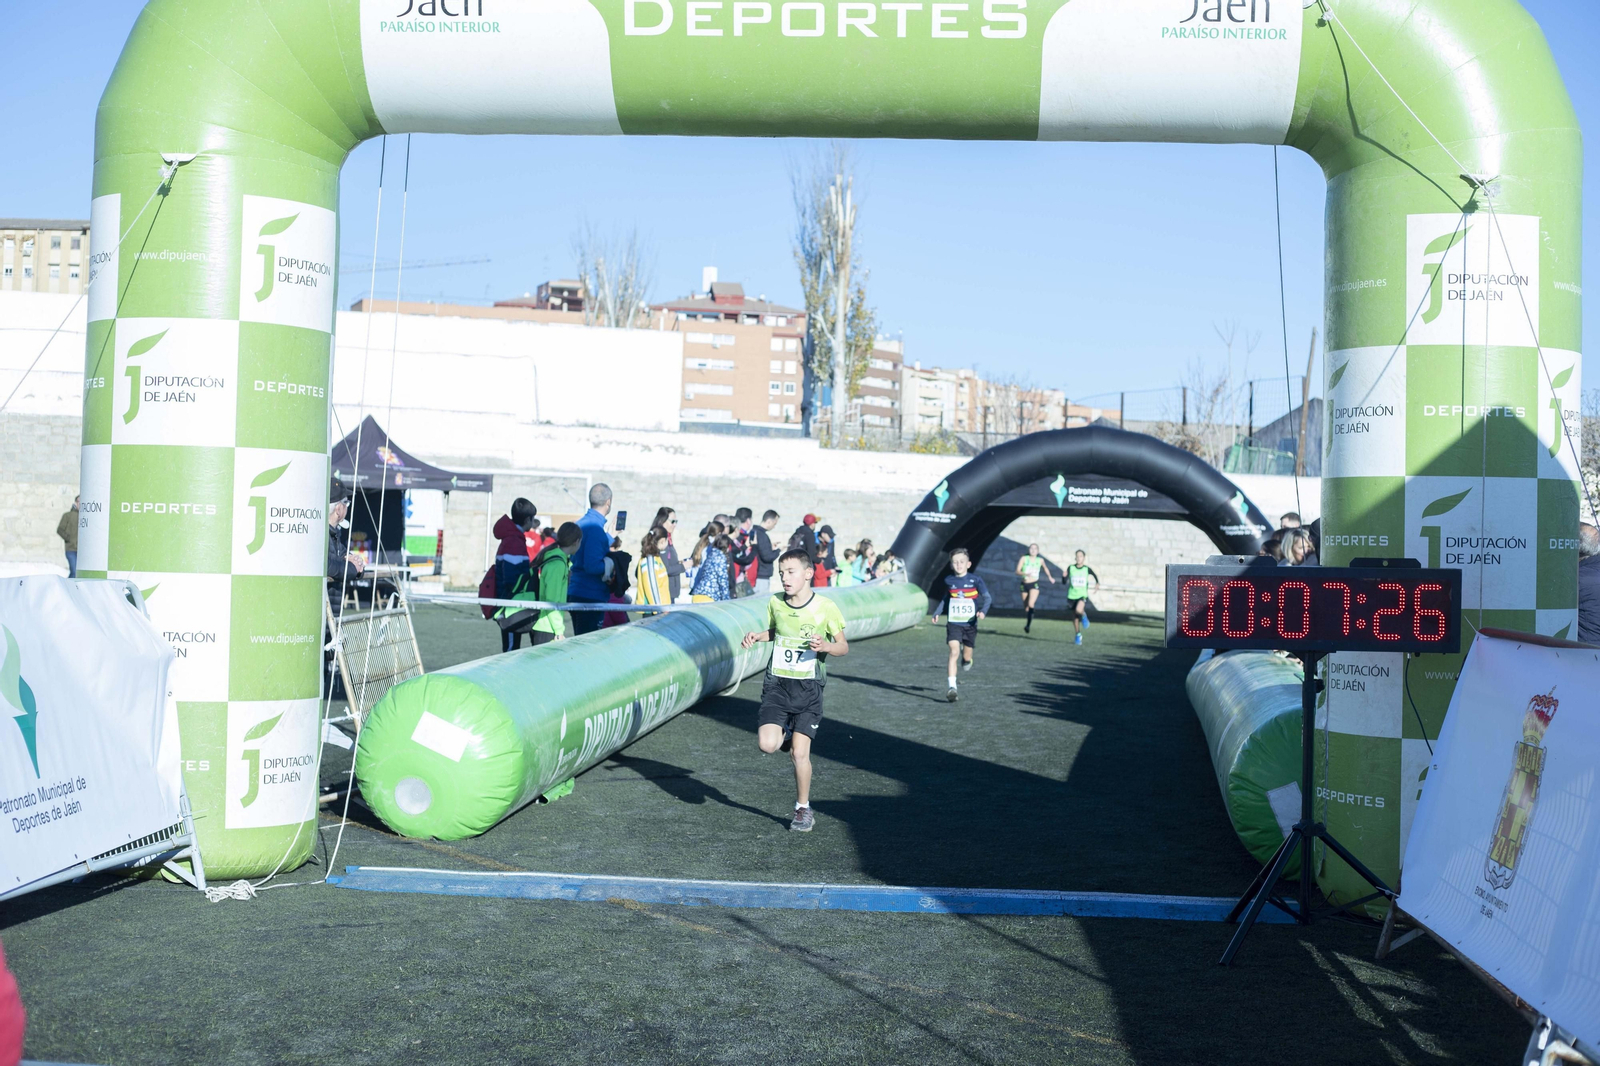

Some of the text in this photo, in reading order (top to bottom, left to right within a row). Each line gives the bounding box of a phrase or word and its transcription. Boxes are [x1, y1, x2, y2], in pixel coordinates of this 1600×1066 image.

[380, 18, 501, 33] PARAÍSO INTERIOR
[623, 0, 1028, 39] DEPORTES
[1161, 25, 1287, 40] PARAÍSO INTERIOR
[278, 256, 331, 276] DIPUTACIÓN
[278, 271, 318, 288] DE JAÉN
[1448, 272, 1529, 286] DIPUTACIÓN
[1448, 288, 1503, 301] DE JAÉN
[144, 375, 225, 388] DIPUTACIÓN
[144, 390, 196, 402] DE JAÉN
[254, 380, 324, 398] DEPORTES
[1335, 404, 1394, 419] DIPUTACIÓN
[1423, 404, 1526, 418] DEPORTES
[1335, 421, 1370, 435] DE JAÉN
[1068, 486, 1149, 498] Patronato Municipal de
[1068, 494, 1101, 504] Deportes
[1101, 495, 1111, 504] de
[121, 502, 217, 515] DEPORTES
[270, 506, 322, 520] DIPUTACIÓN
[270, 521, 309, 534] DE JAÉN
[1325, 535, 1389, 547] DEPORTES
[1446, 536, 1527, 549] DIPUTACIÓN
[1446, 552, 1501, 564] DE JAÉN
[951, 605, 973, 614] 1153
[1182, 579, 1446, 641] 00:07:26
[250, 632, 315, 645] www.dipujaen.es
[784, 649, 804, 664] 97
[1330, 663, 1390, 678] DIPUTACIÓN
[1330, 678, 1366, 692] DE JAÉN
[263, 753, 314, 769] DIPUTACIÓN
[263, 770, 301, 785] DE JAÉN
[37, 777, 76, 803] Municipal
[76, 775, 87, 791] de
[1316, 786, 1385, 808] DEPORTES
[12, 798, 82, 834] Deportes de Jaén
